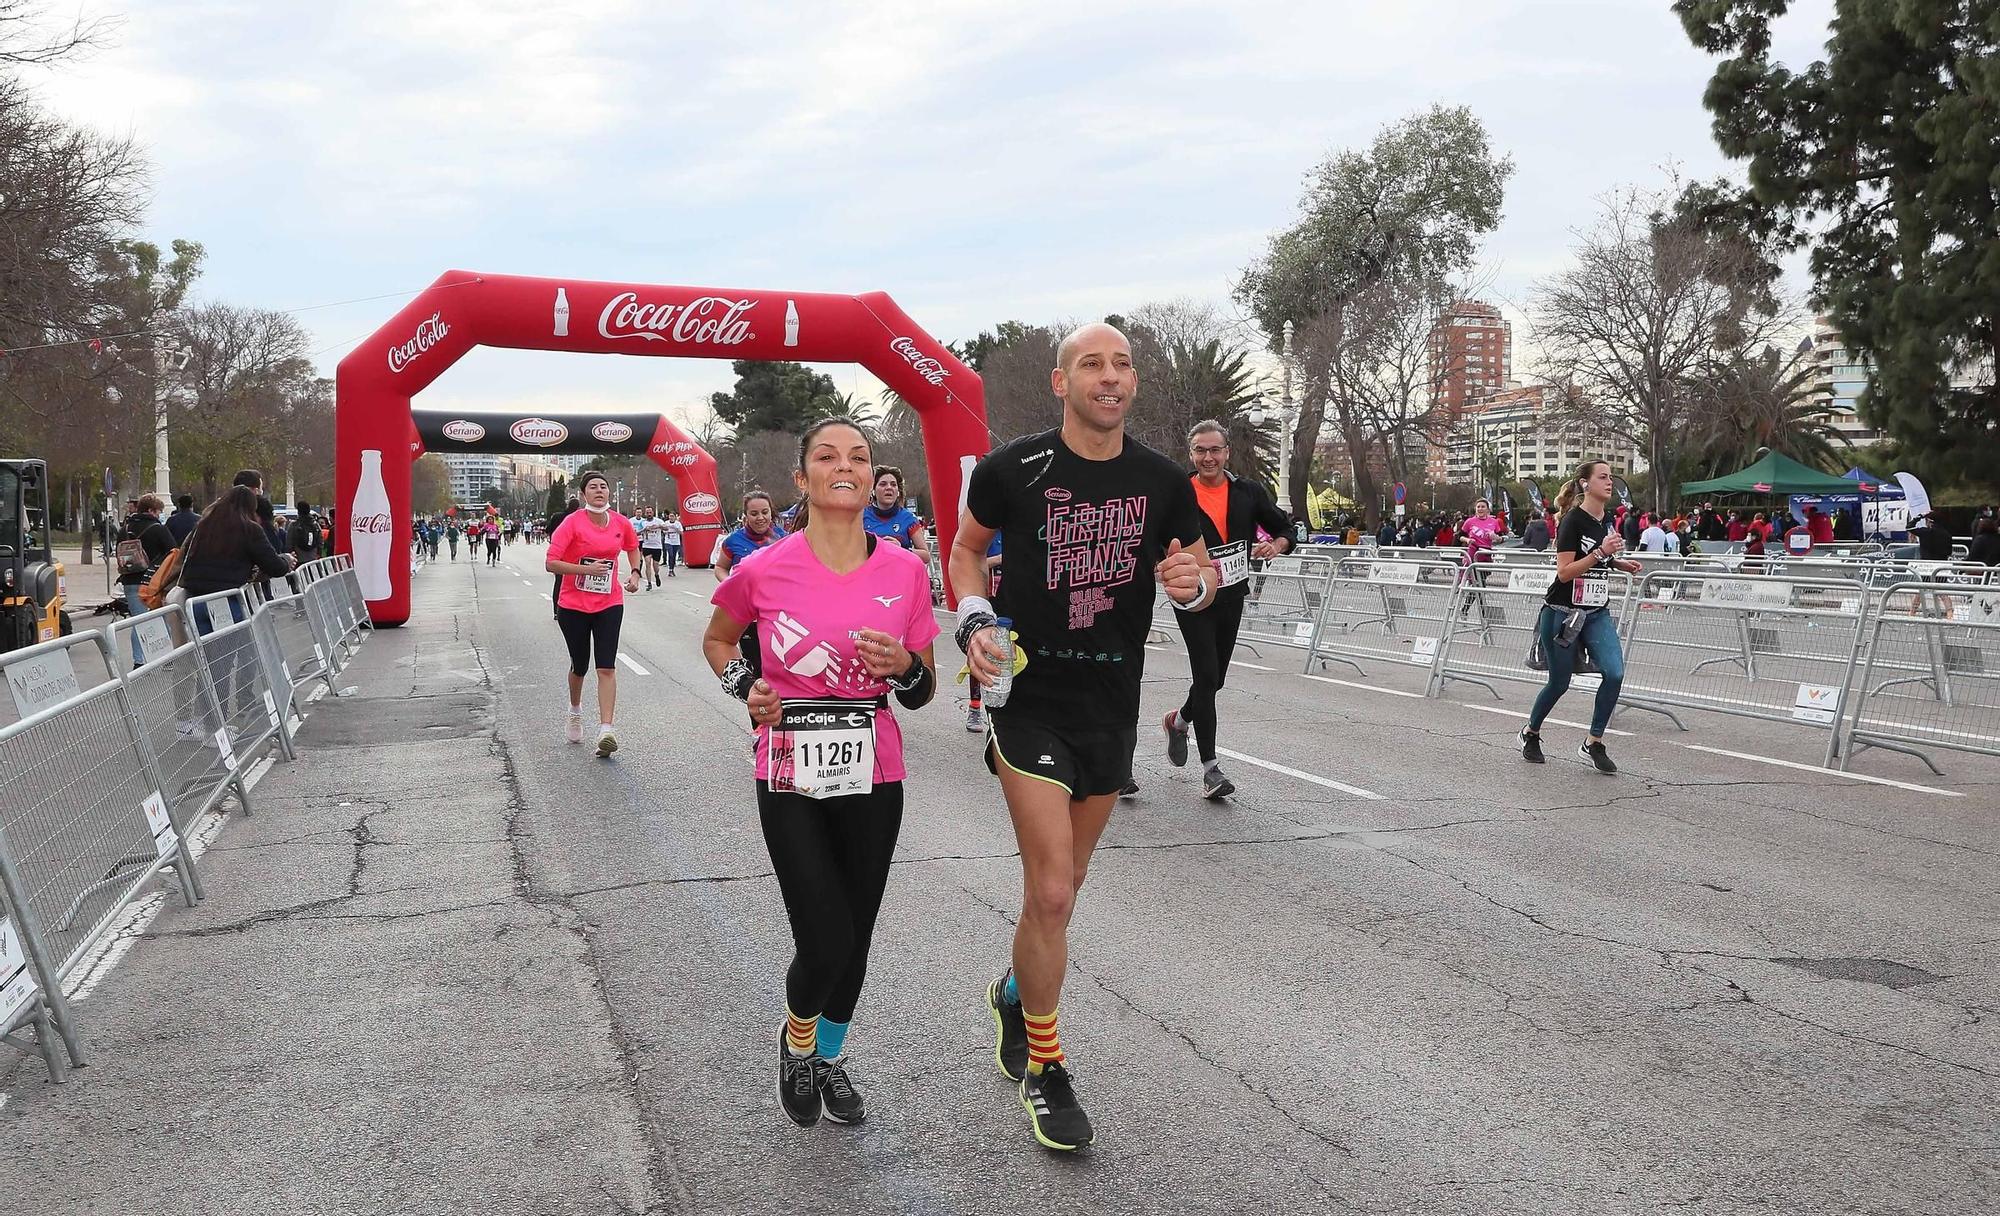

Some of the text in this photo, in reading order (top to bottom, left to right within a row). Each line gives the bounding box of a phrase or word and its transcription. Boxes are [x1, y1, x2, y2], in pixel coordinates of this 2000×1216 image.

[598, 292, 759, 345] Coca-Cola
[387, 311, 450, 373] Coca-Cola
[890, 336, 953, 386] Coca-Cola
[448, 424, 481, 436] Serrano
[516, 425, 562, 438] Serrano
[597, 427, 628, 437] Serrano
[1021, 451, 1046, 464] luanvi
[1047, 490, 1069, 499] Serrano
[687, 497, 717, 509] Serrano
[1223, 556, 1245, 573] 11416
[801, 740, 863, 767] 11261
[817, 766, 851, 779] ALMAIRIS
